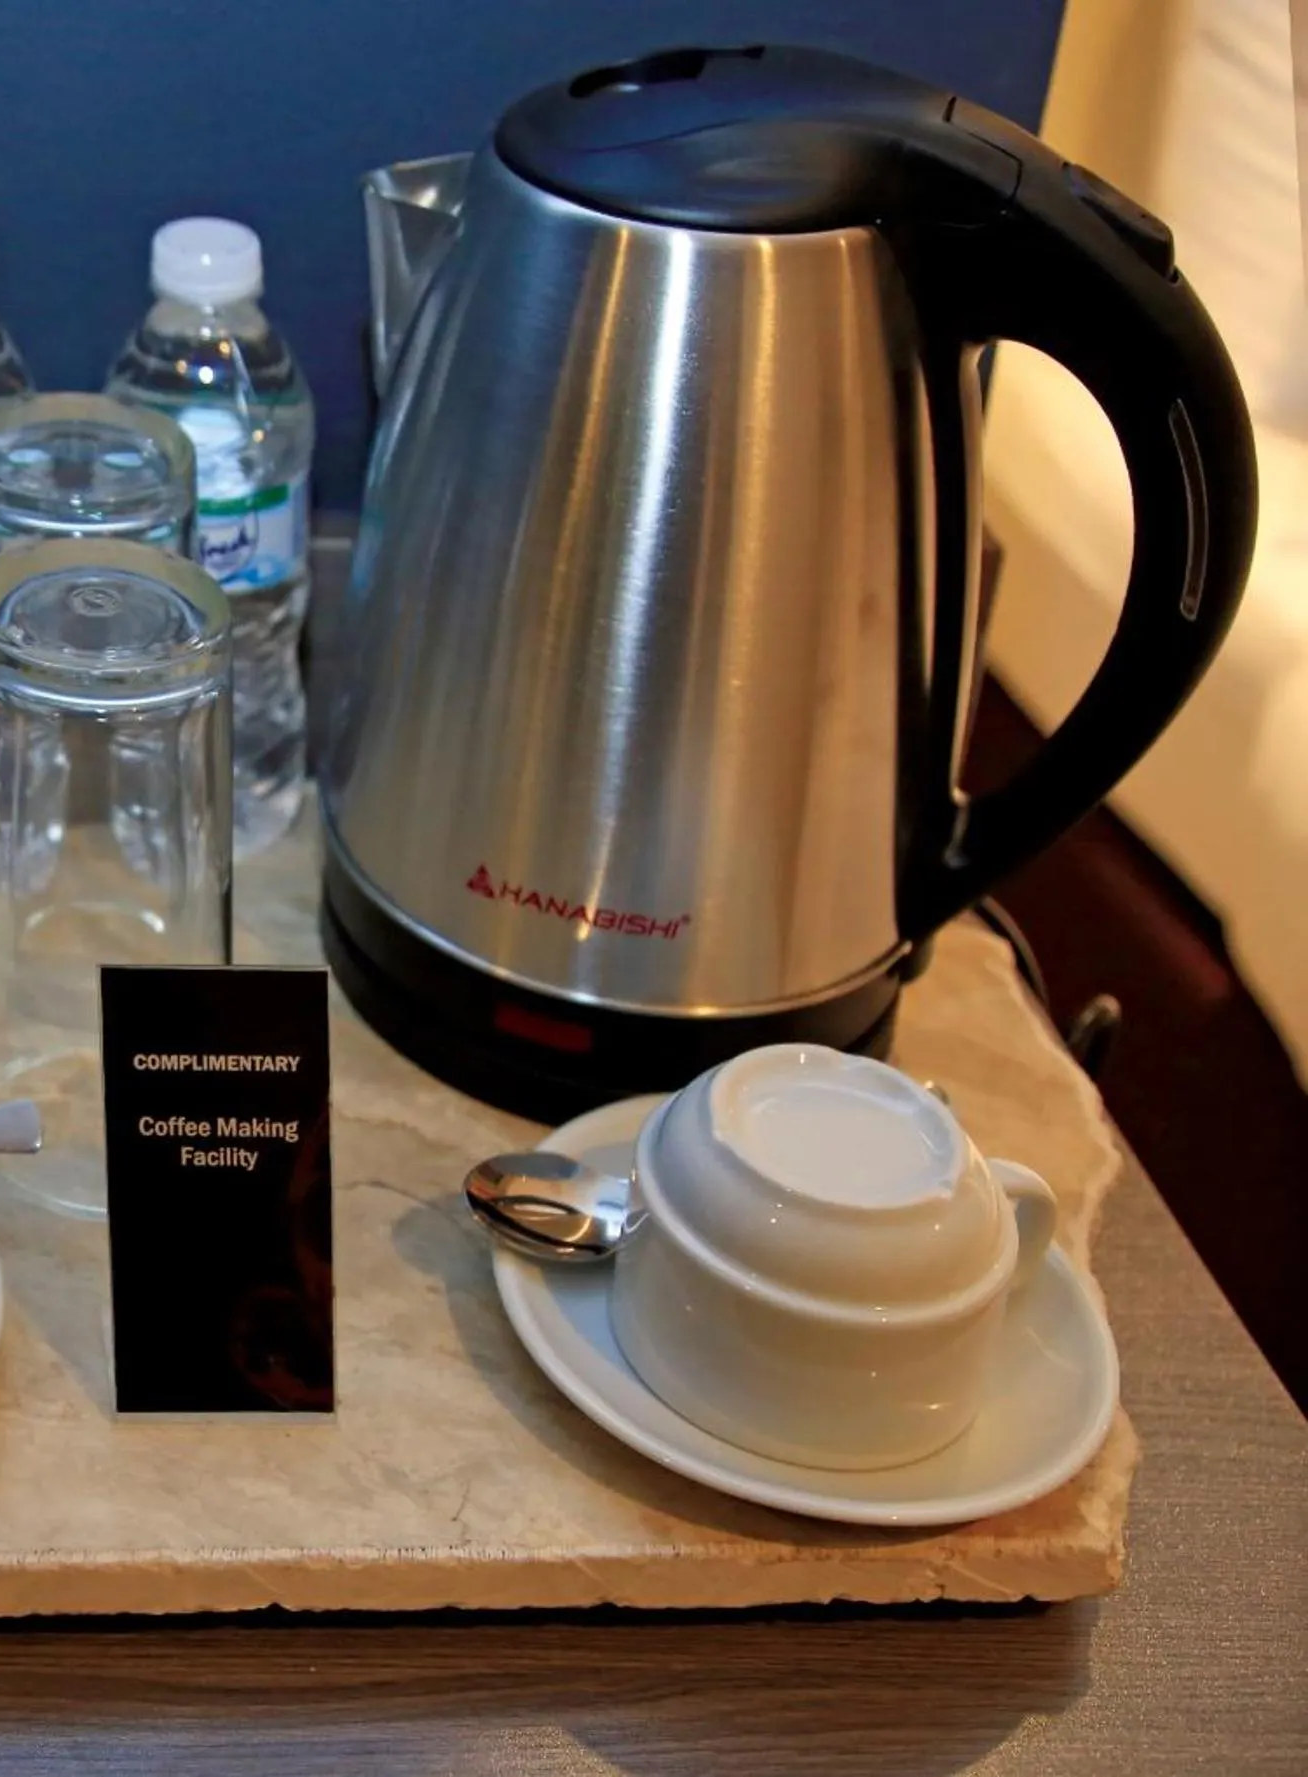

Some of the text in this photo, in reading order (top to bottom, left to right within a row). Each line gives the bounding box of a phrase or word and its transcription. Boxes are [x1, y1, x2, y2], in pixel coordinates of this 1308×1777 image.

[498, 880, 680, 940] HANABISHI
[133, 1053, 300, 1073] COMPLIMENTARY
[139, 1117, 299, 1142] Coffee Making
[181, 1146, 258, 1171] Facility
